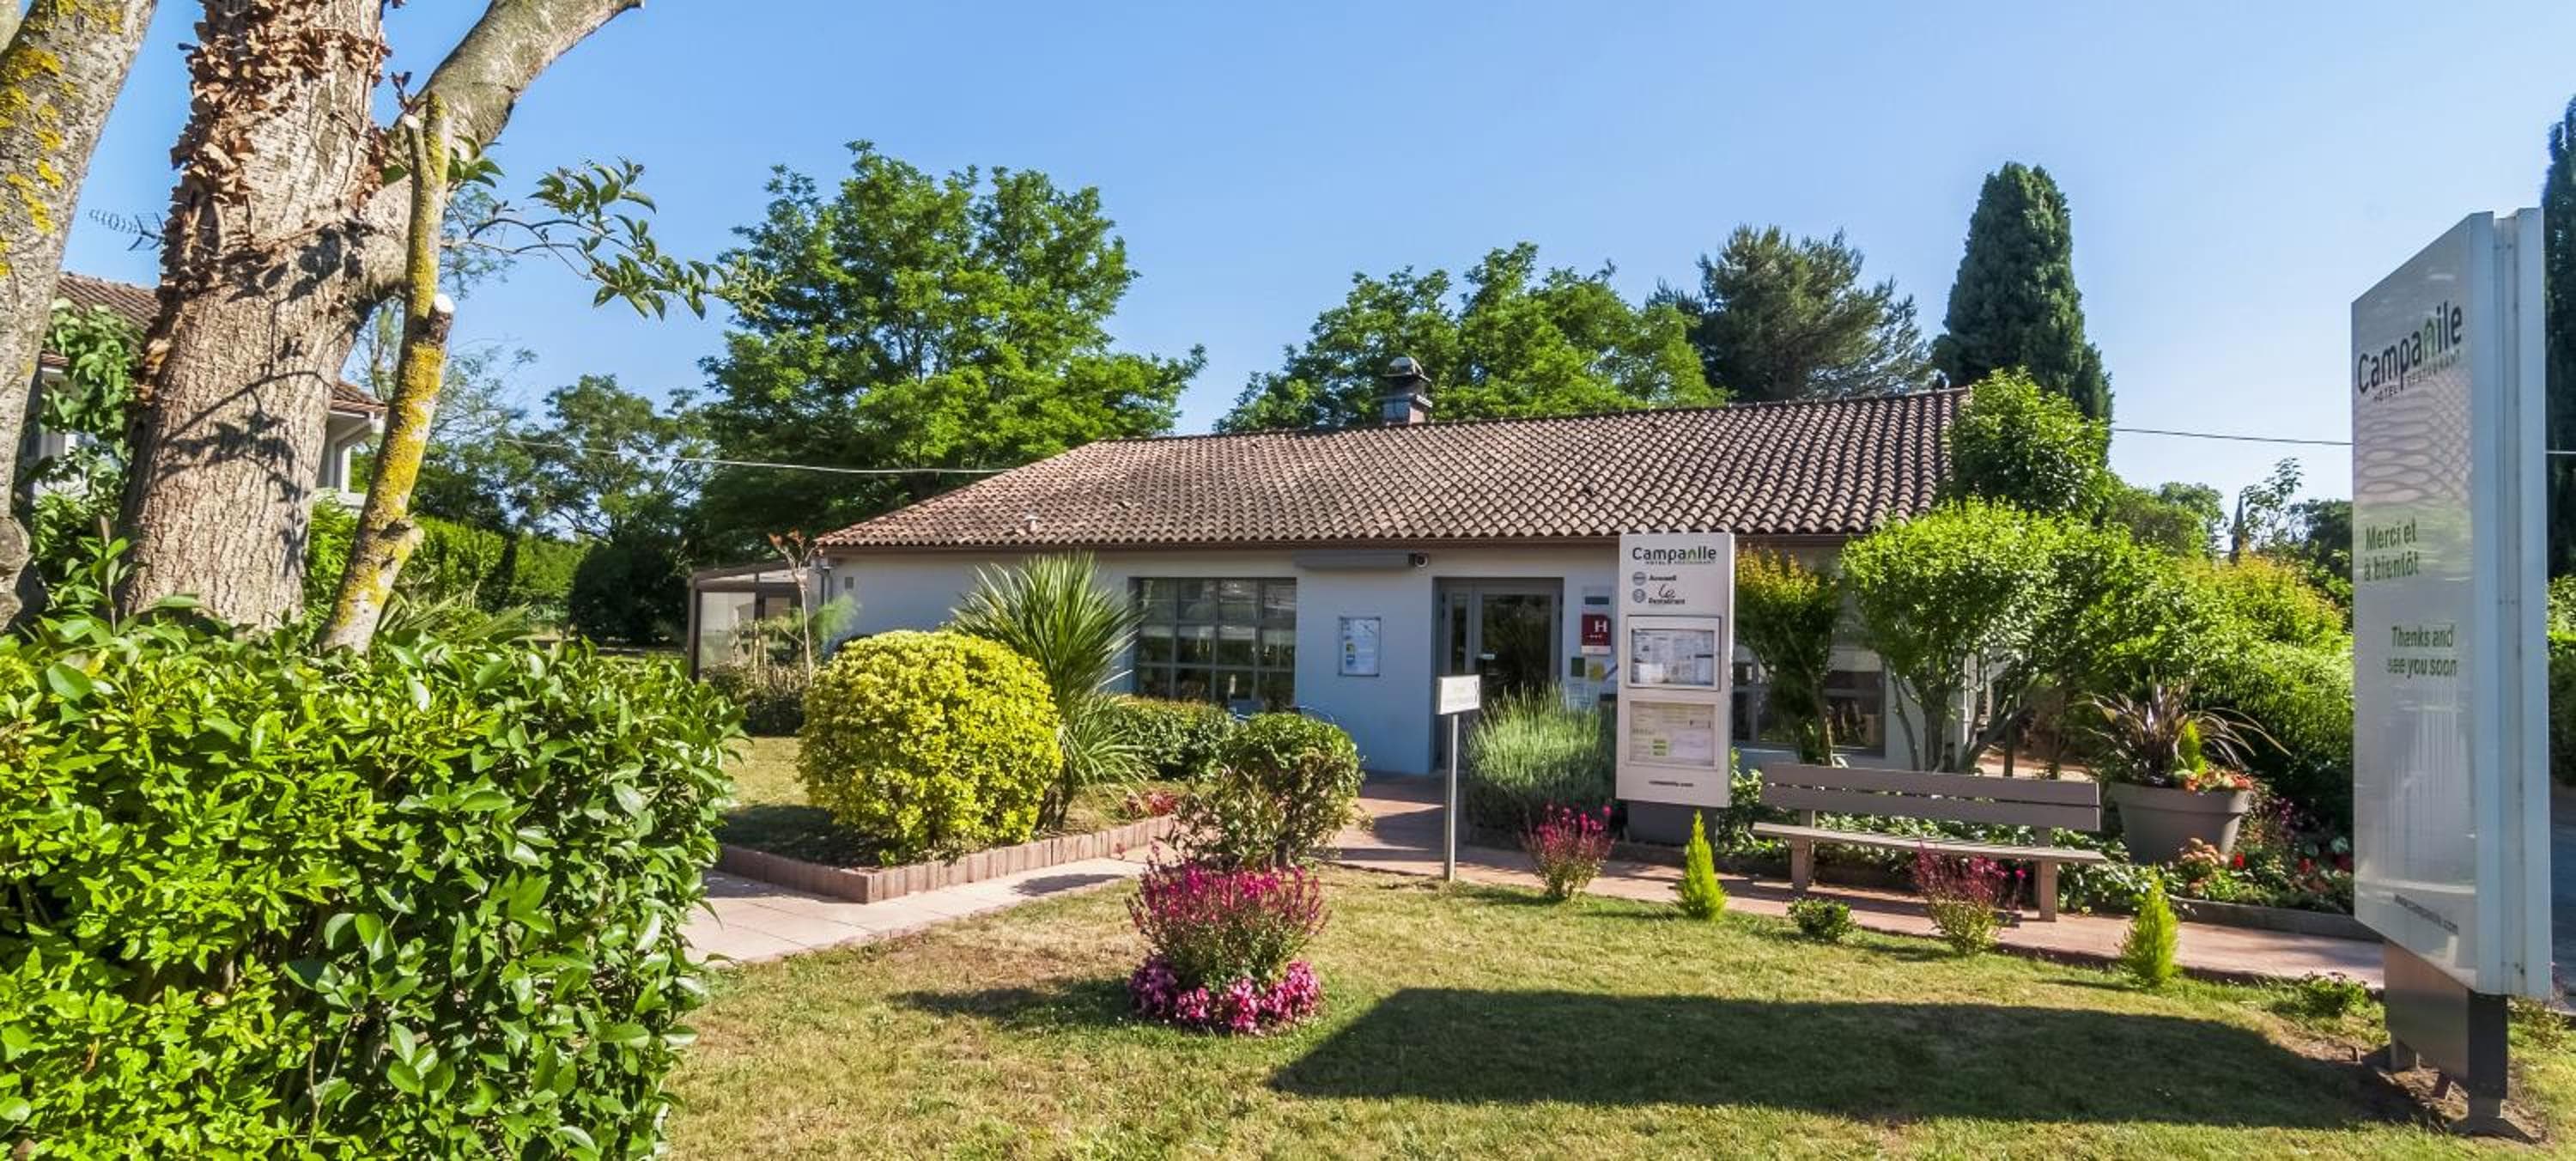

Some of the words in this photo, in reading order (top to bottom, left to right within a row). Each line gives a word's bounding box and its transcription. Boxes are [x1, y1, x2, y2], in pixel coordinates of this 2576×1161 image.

[2358, 299, 2462, 394] Campanile
[2366, 520, 2401, 550] Merci
[2404, 517, 2417, 544] et
[1632, 546, 1716, 564] Campanile
[2374, 550, 2420, 580] bientôt
[1595, 620, 1607, 633] H
[2391, 625, 2431, 647] Thanks
[2433, 624, 2454, 647] and
[2387, 659, 2405, 674] see
[2407, 658, 2427, 680] you
[2429, 659, 2458, 678] soon
